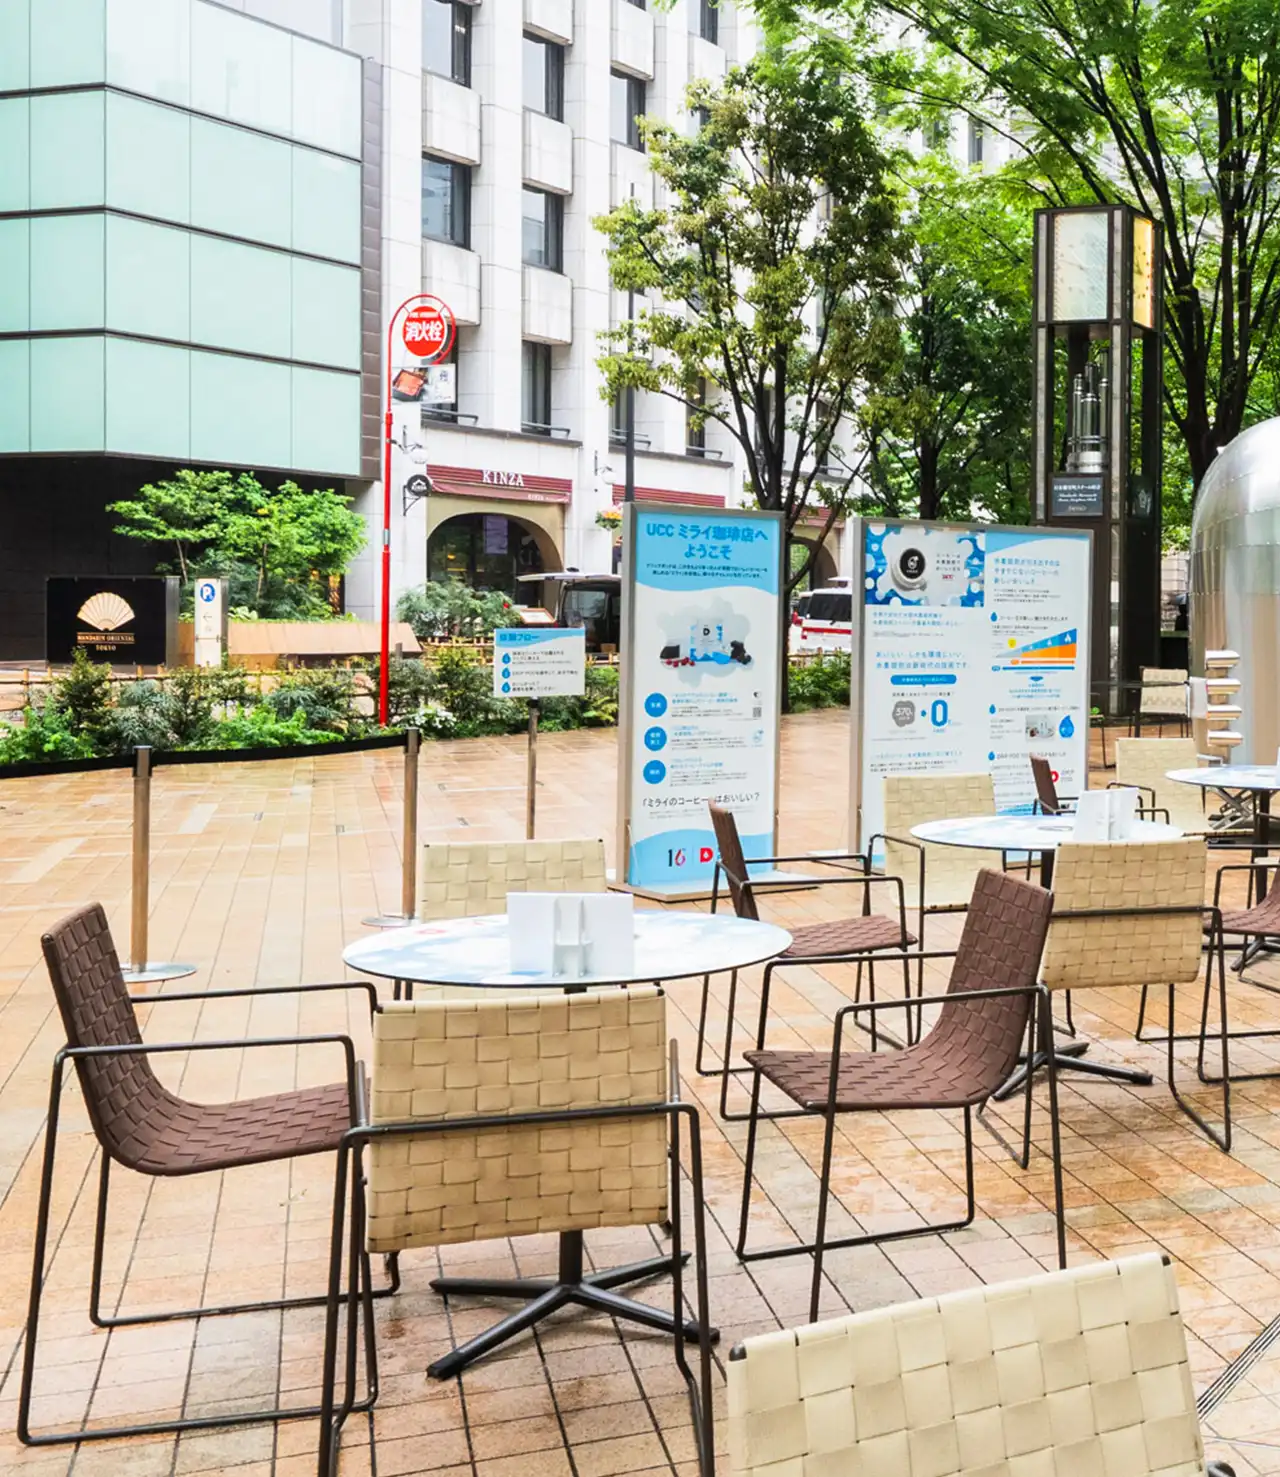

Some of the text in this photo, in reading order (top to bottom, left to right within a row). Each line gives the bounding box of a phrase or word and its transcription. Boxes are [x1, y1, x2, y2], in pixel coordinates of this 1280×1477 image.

[405, 321, 442, 341] 消火栓
[482, 470, 524, 486] KINZA
[646, 523, 768, 542] UCC ミライ珈琲店へ
[684, 544, 732, 560] ようこそ
[703, 628, 710, 636] D
